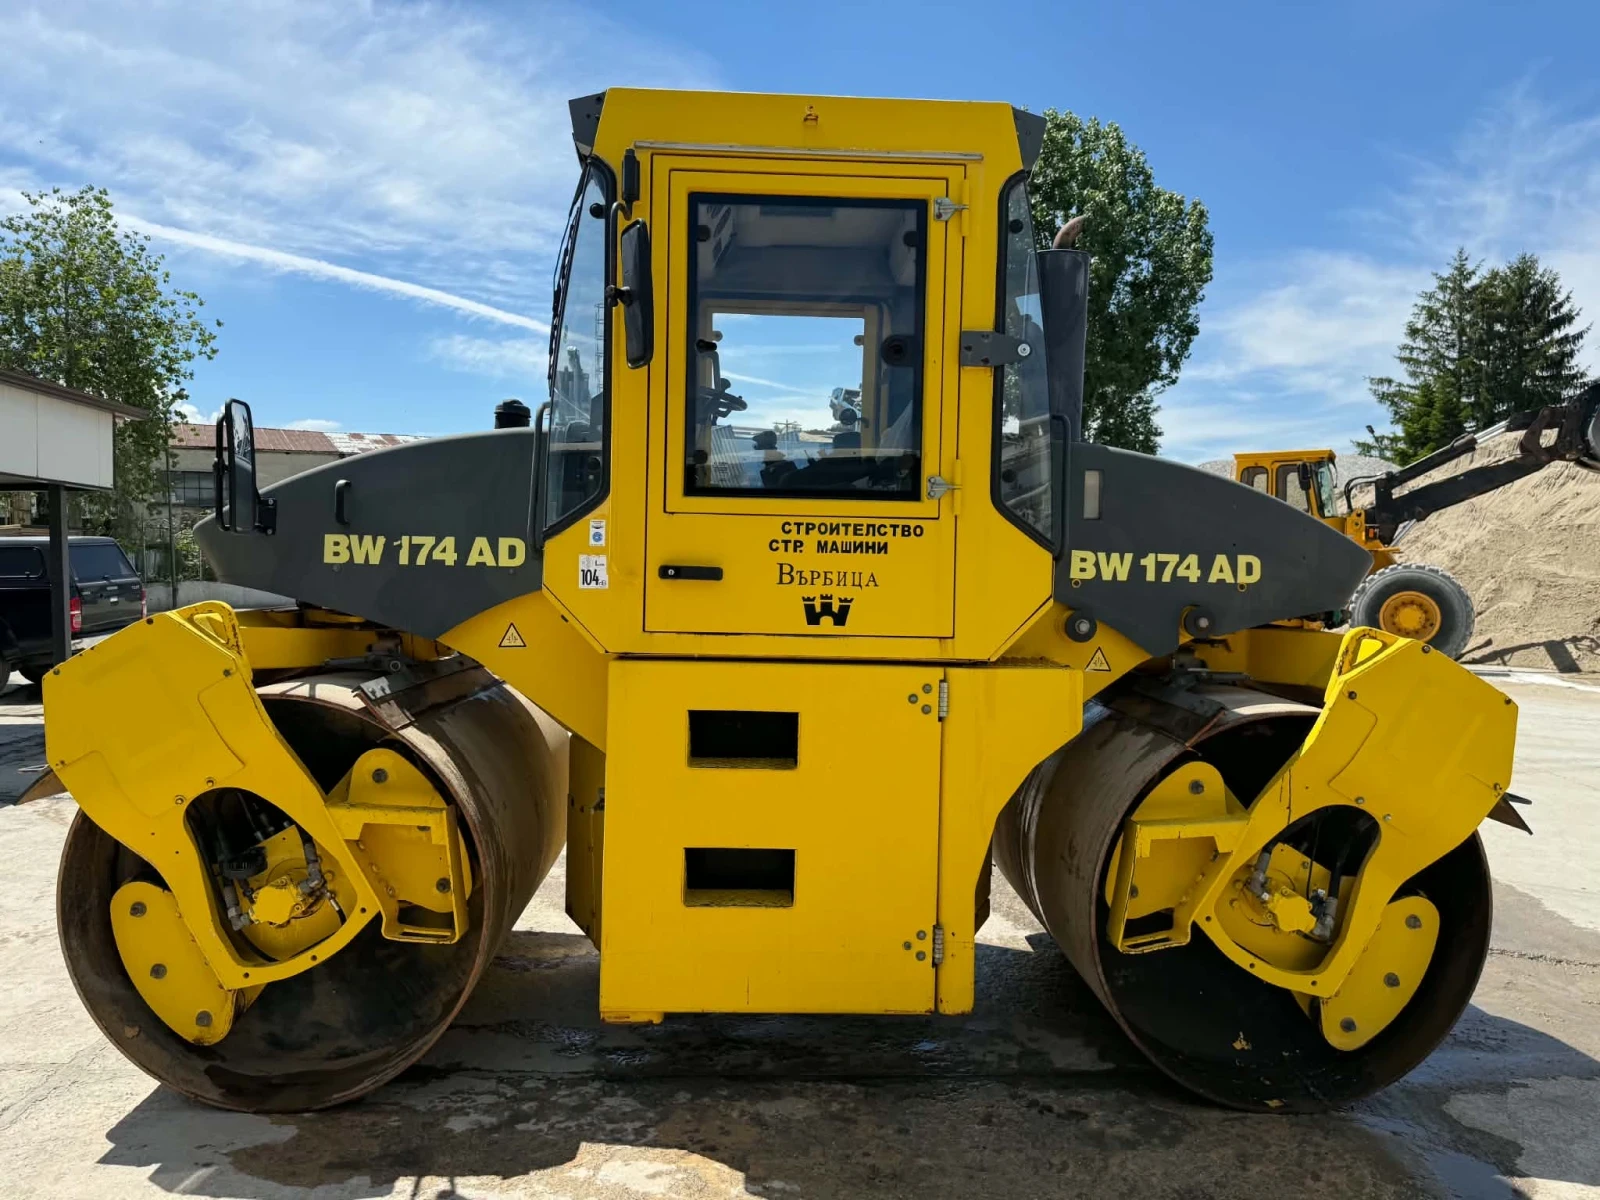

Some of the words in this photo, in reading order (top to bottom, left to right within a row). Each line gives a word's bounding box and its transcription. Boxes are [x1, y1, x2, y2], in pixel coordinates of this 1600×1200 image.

[781, 521, 925, 538] СТРОИТЕЛСТВО
[323, 534, 387, 565] BW
[393, 535, 458, 567] 174
[466, 536, 526, 567] AD
[768, 539, 804, 554] СТР.
[816, 540, 889, 555] МАШИНИ
[1069, 549, 1134, 582] BW
[1140, 552, 1201, 583] 174
[1207, 554, 1262, 584] AD
[581, 569, 599, 586] 104
